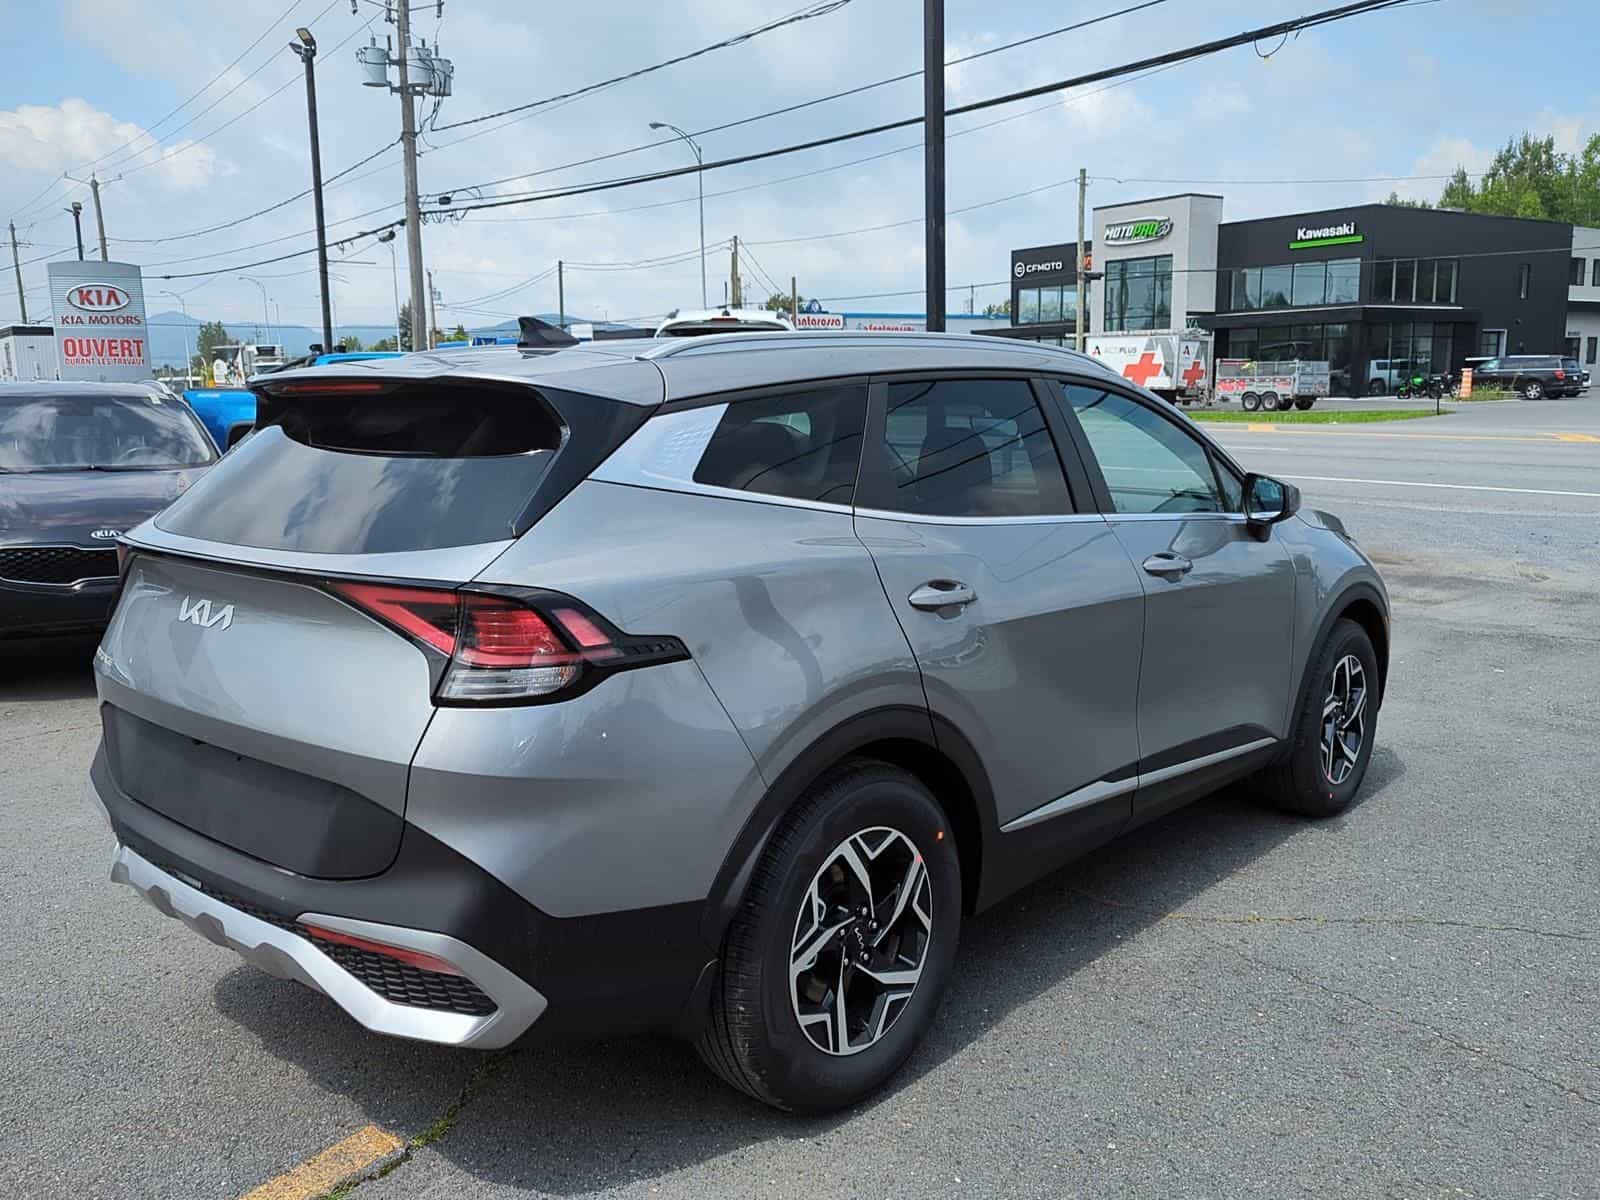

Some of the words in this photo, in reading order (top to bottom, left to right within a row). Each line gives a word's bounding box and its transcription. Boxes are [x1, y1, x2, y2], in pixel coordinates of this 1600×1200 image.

[1297, 222, 1355, 241] Kawasaki
[1026, 261, 1063, 273] CFMOTO
[77, 289, 122, 306] KIA
[61, 315, 85, 325] KIA
[88, 315, 142, 326] MOTORS
[64, 338, 144, 358] OUVERT
[178, 595, 235, 631] KIA
